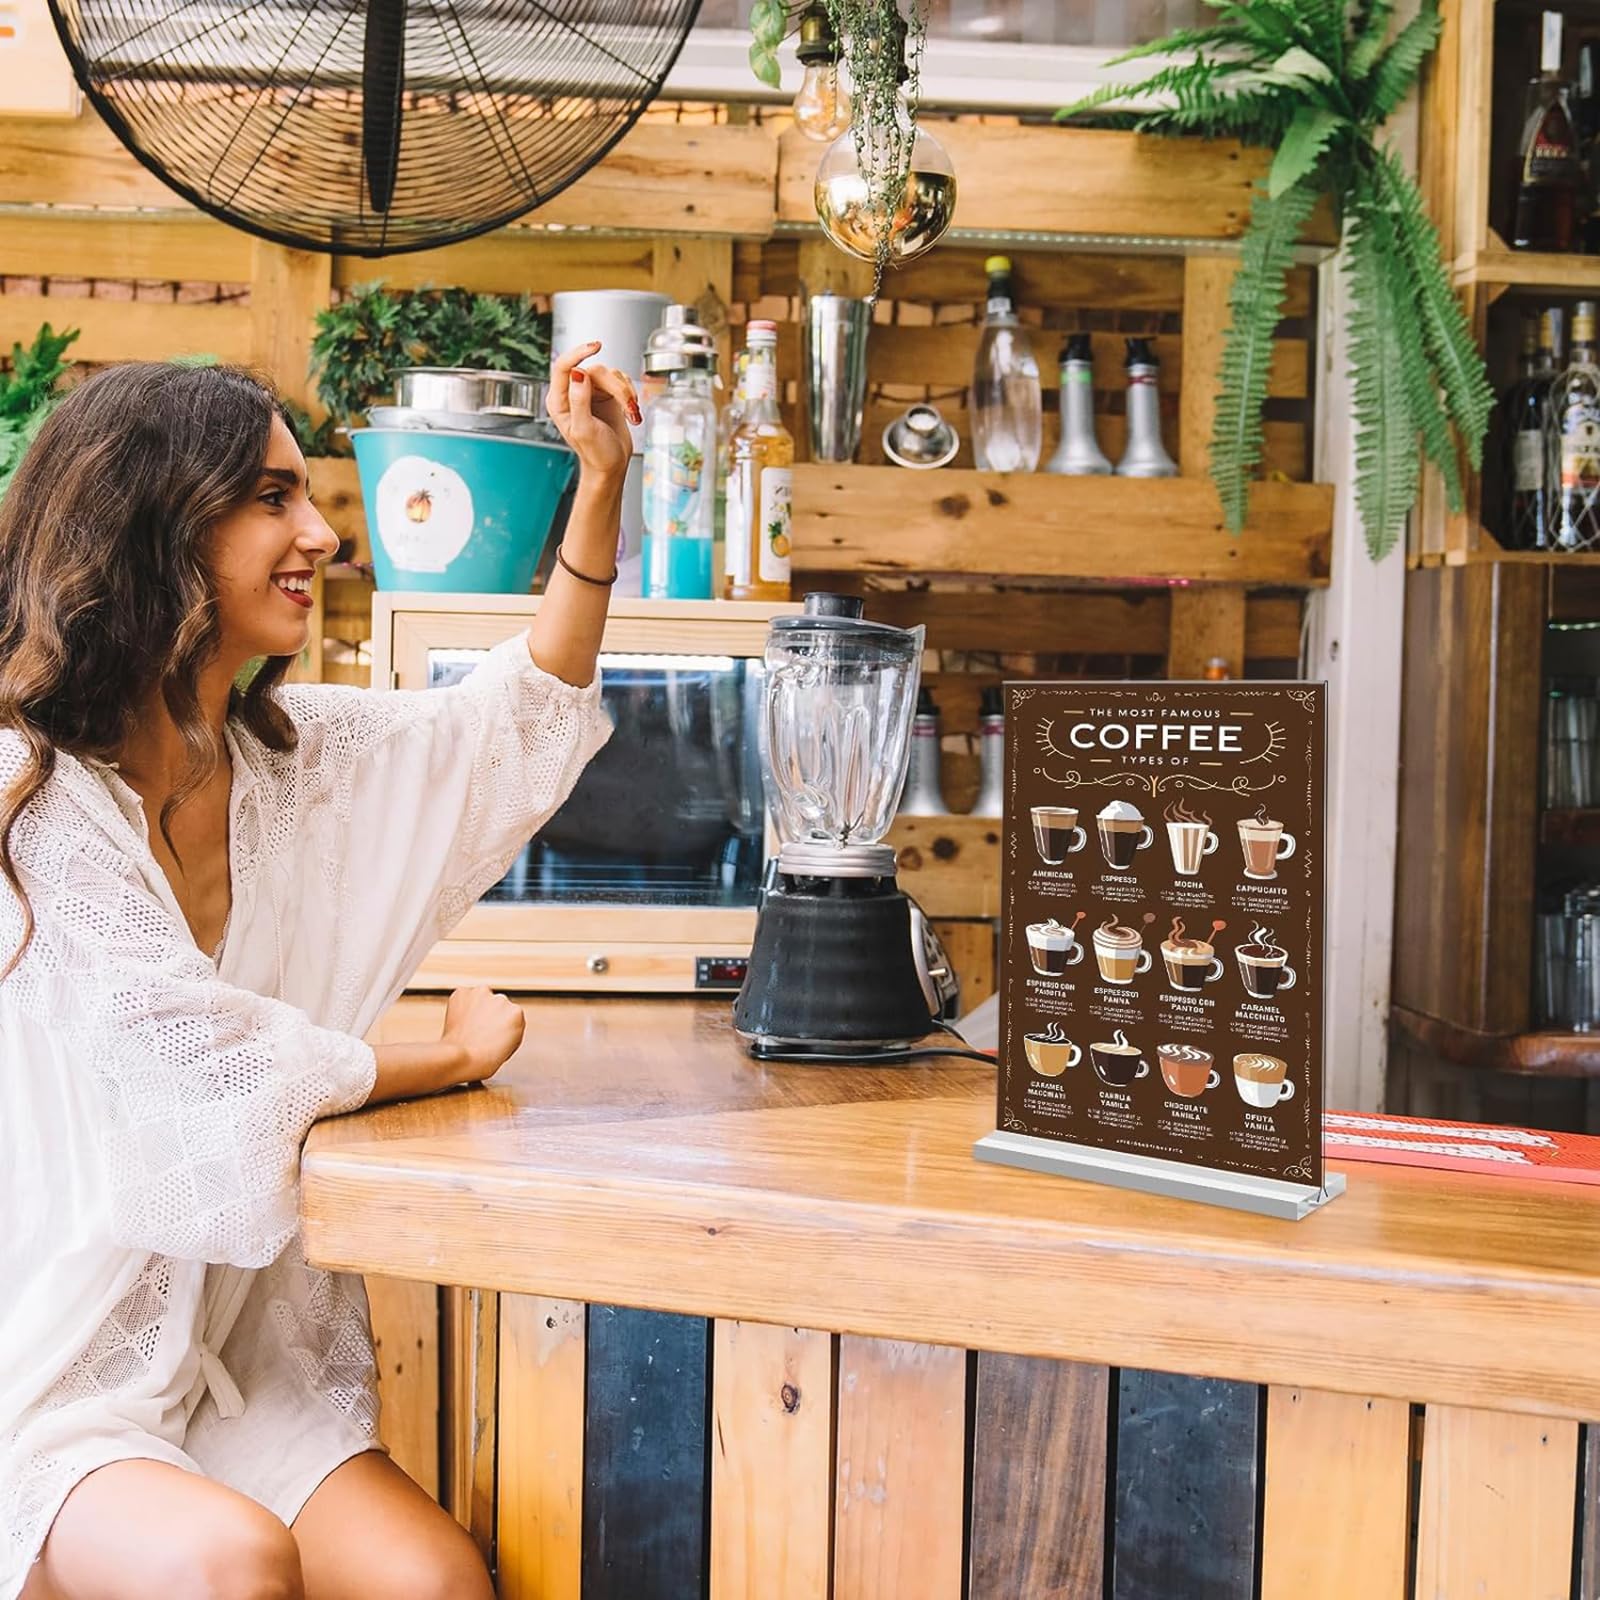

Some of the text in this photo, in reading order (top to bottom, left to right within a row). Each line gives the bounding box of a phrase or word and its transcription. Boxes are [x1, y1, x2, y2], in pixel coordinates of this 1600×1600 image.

[1089, 708, 1221, 718] THE MOST FAMOUS
[1070, 723, 1243, 752] COFFEE
[1121, 756, 1189, 766] TYPES OF
[1032, 870, 1074, 880] AMERICANO
[1174, 880, 1204, 889] MOCHA
[1241, 1003, 1280, 1014] CARAMEL
